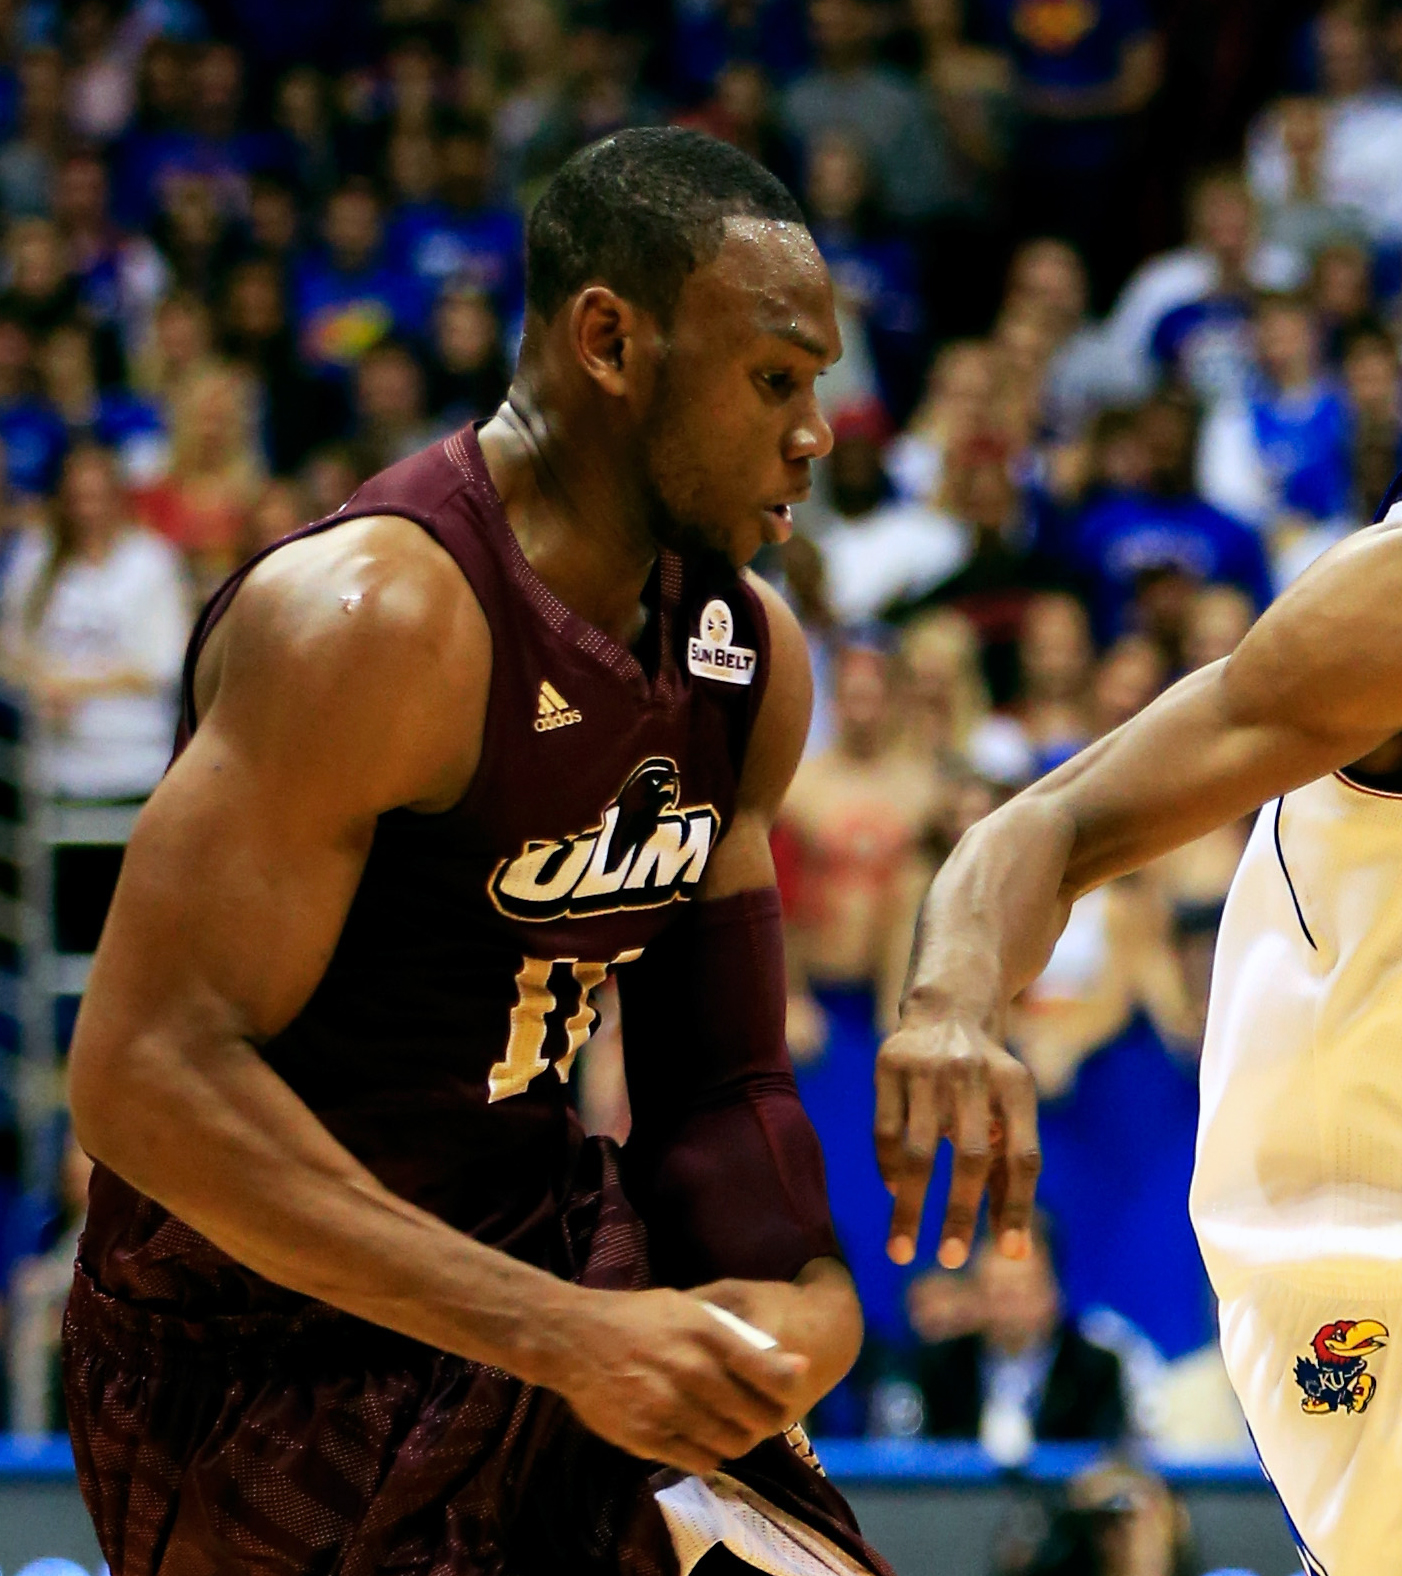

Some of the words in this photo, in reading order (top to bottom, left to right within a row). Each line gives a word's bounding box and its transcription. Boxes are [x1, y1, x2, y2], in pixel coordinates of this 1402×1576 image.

[715, 648, 753, 670] BELT
[534, 710, 582, 732] adidas
[494, 804, 716, 908] ULM
[1318, 1371, 1345, 1391] KU
